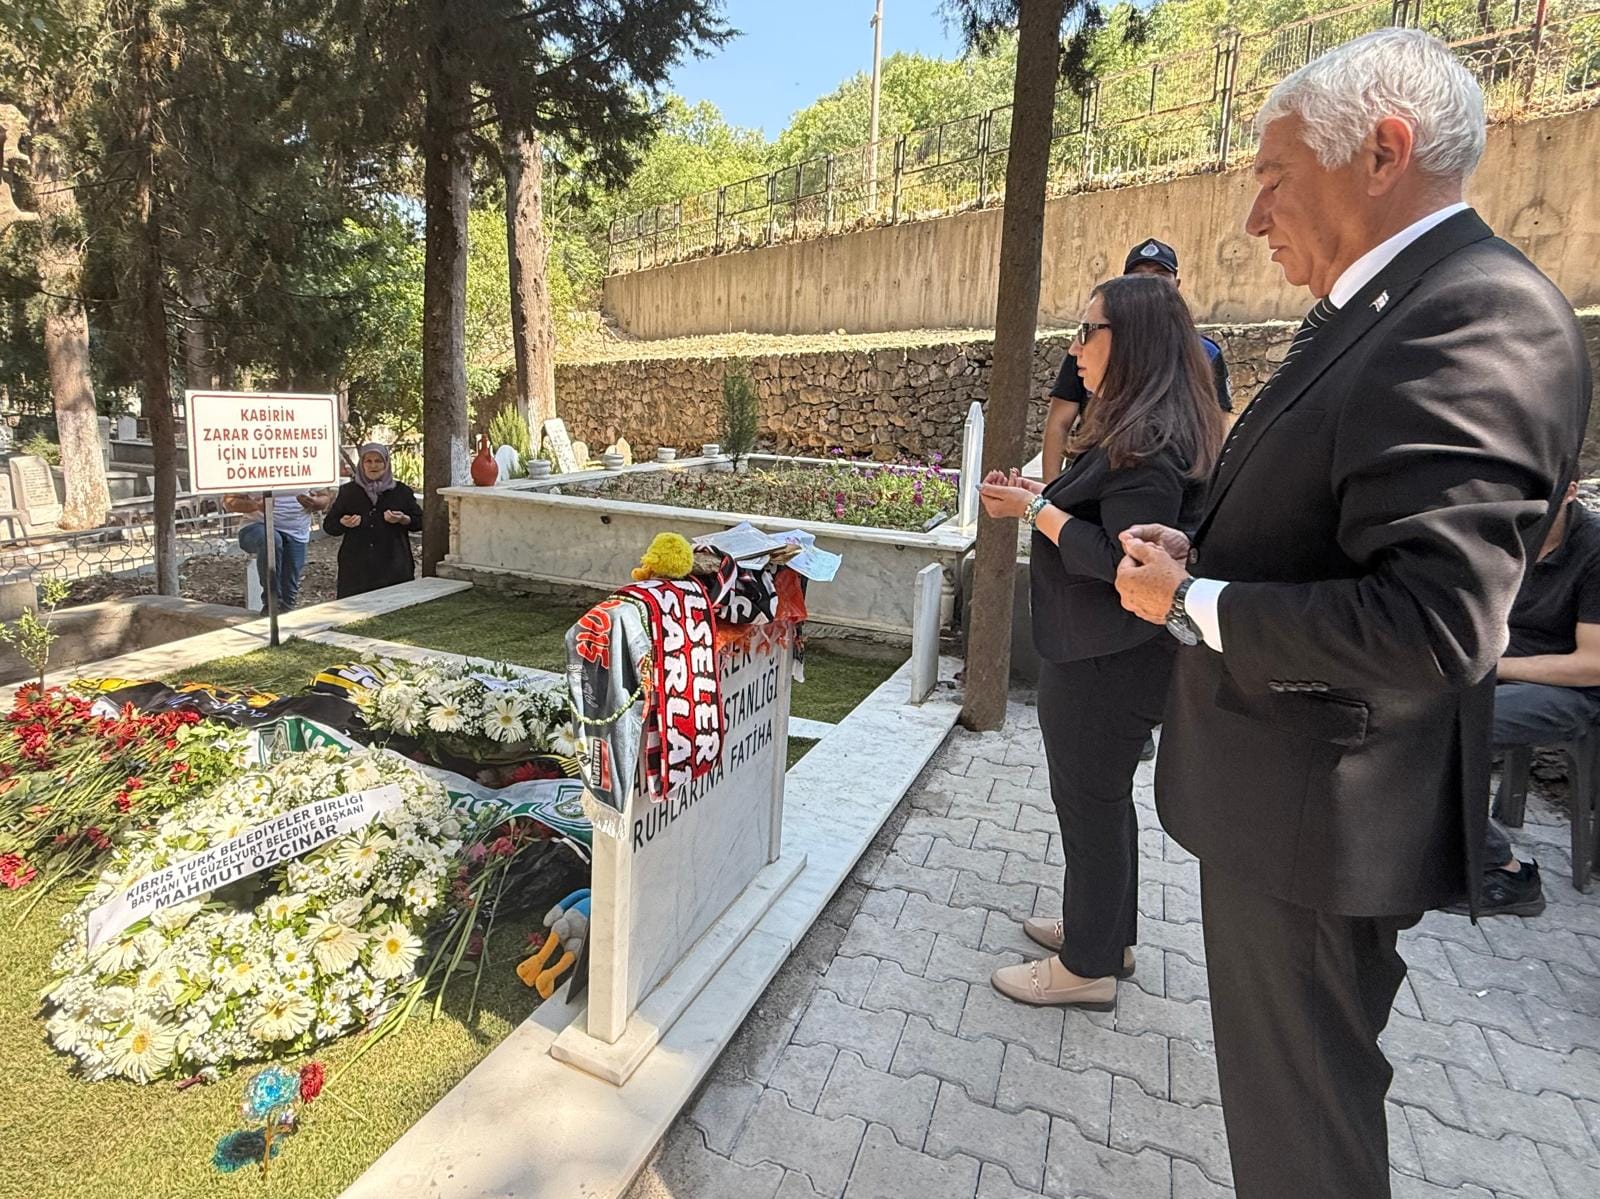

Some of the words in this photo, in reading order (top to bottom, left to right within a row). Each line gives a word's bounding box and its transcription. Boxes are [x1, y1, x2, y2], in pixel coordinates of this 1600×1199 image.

[203, 429, 249, 441] ZARAR
[254, 425, 328, 440] GÖRMEMESİ
[241, 406, 295, 421] KABİRİN
[218, 444, 246, 464] İÇİN
[252, 444, 298, 460] LÜTFEN
[302, 447, 317, 457] SU
[227, 461, 311, 479] DÖKMEYELİM
[633, 756, 724, 853] RUHLARINA
[730, 719, 772, 772] FATİHA
[127, 870, 172, 901] KIBRIS
[219, 809, 311, 855] BELEDİYELER
[314, 792, 363, 815] BİRLİĞİ
[131, 879, 179, 909] BAŞKANI
[182, 871, 196, 882] VE
[266, 819, 316, 848] BELEDİYE
[318, 803, 364, 826] BAŞKANI
[156, 862, 243, 909] MAHMUT
[253, 823, 338, 869] ÖZÇINAR
